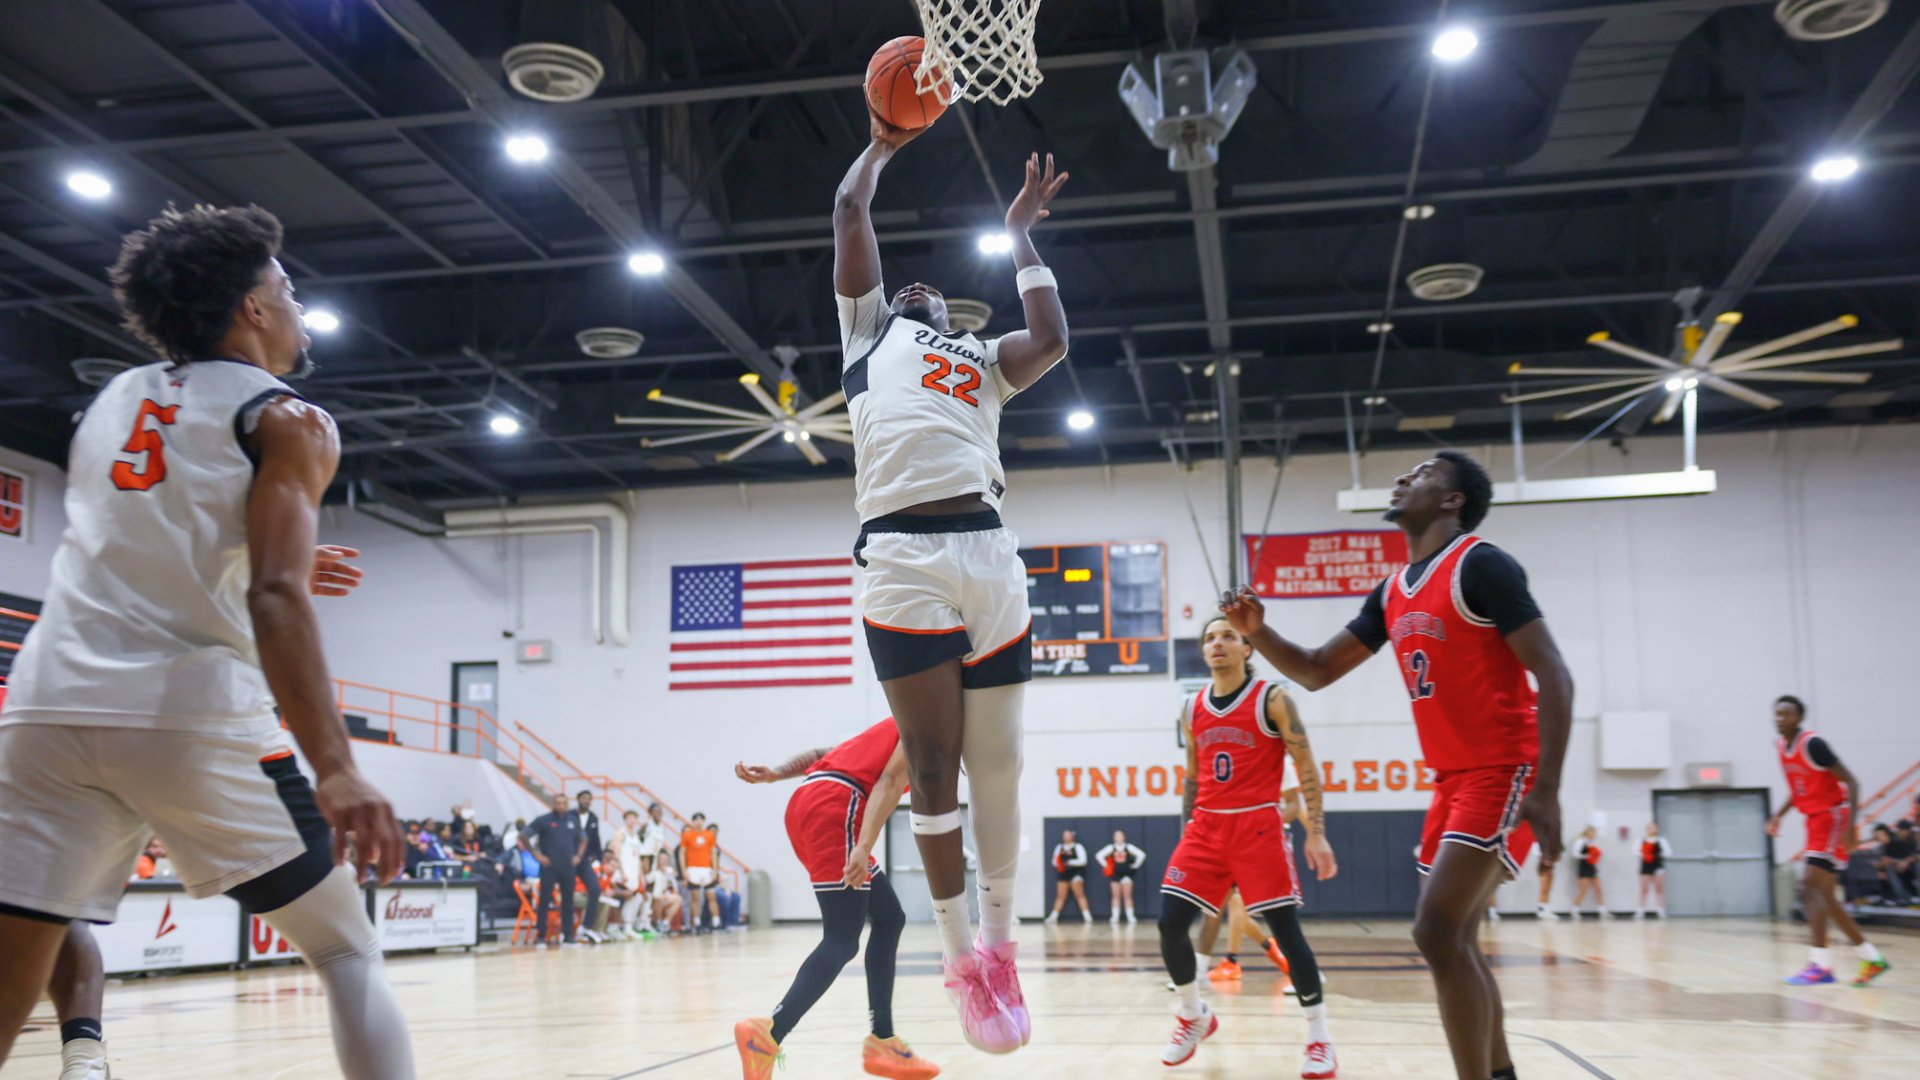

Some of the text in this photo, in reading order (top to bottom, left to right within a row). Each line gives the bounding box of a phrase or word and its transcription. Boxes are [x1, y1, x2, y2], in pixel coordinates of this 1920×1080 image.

[914, 329, 987, 370] Union
[922, 353, 981, 408] 22
[109, 398, 182, 492] 5
[1348, 535, 1382, 549] NAIA
[1305, 550, 1366, 565] DIVISION
[1276, 562, 1405, 579] MEN'S BASKETBA
[1274, 579, 1343, 593] NATIONAL
[1046, 643, 1087, 660] TIRE
[1119, 641, 1139, 665] U
[1402, 649, 1435, 702] 12
[1213, 751, 1235, 783] 0
